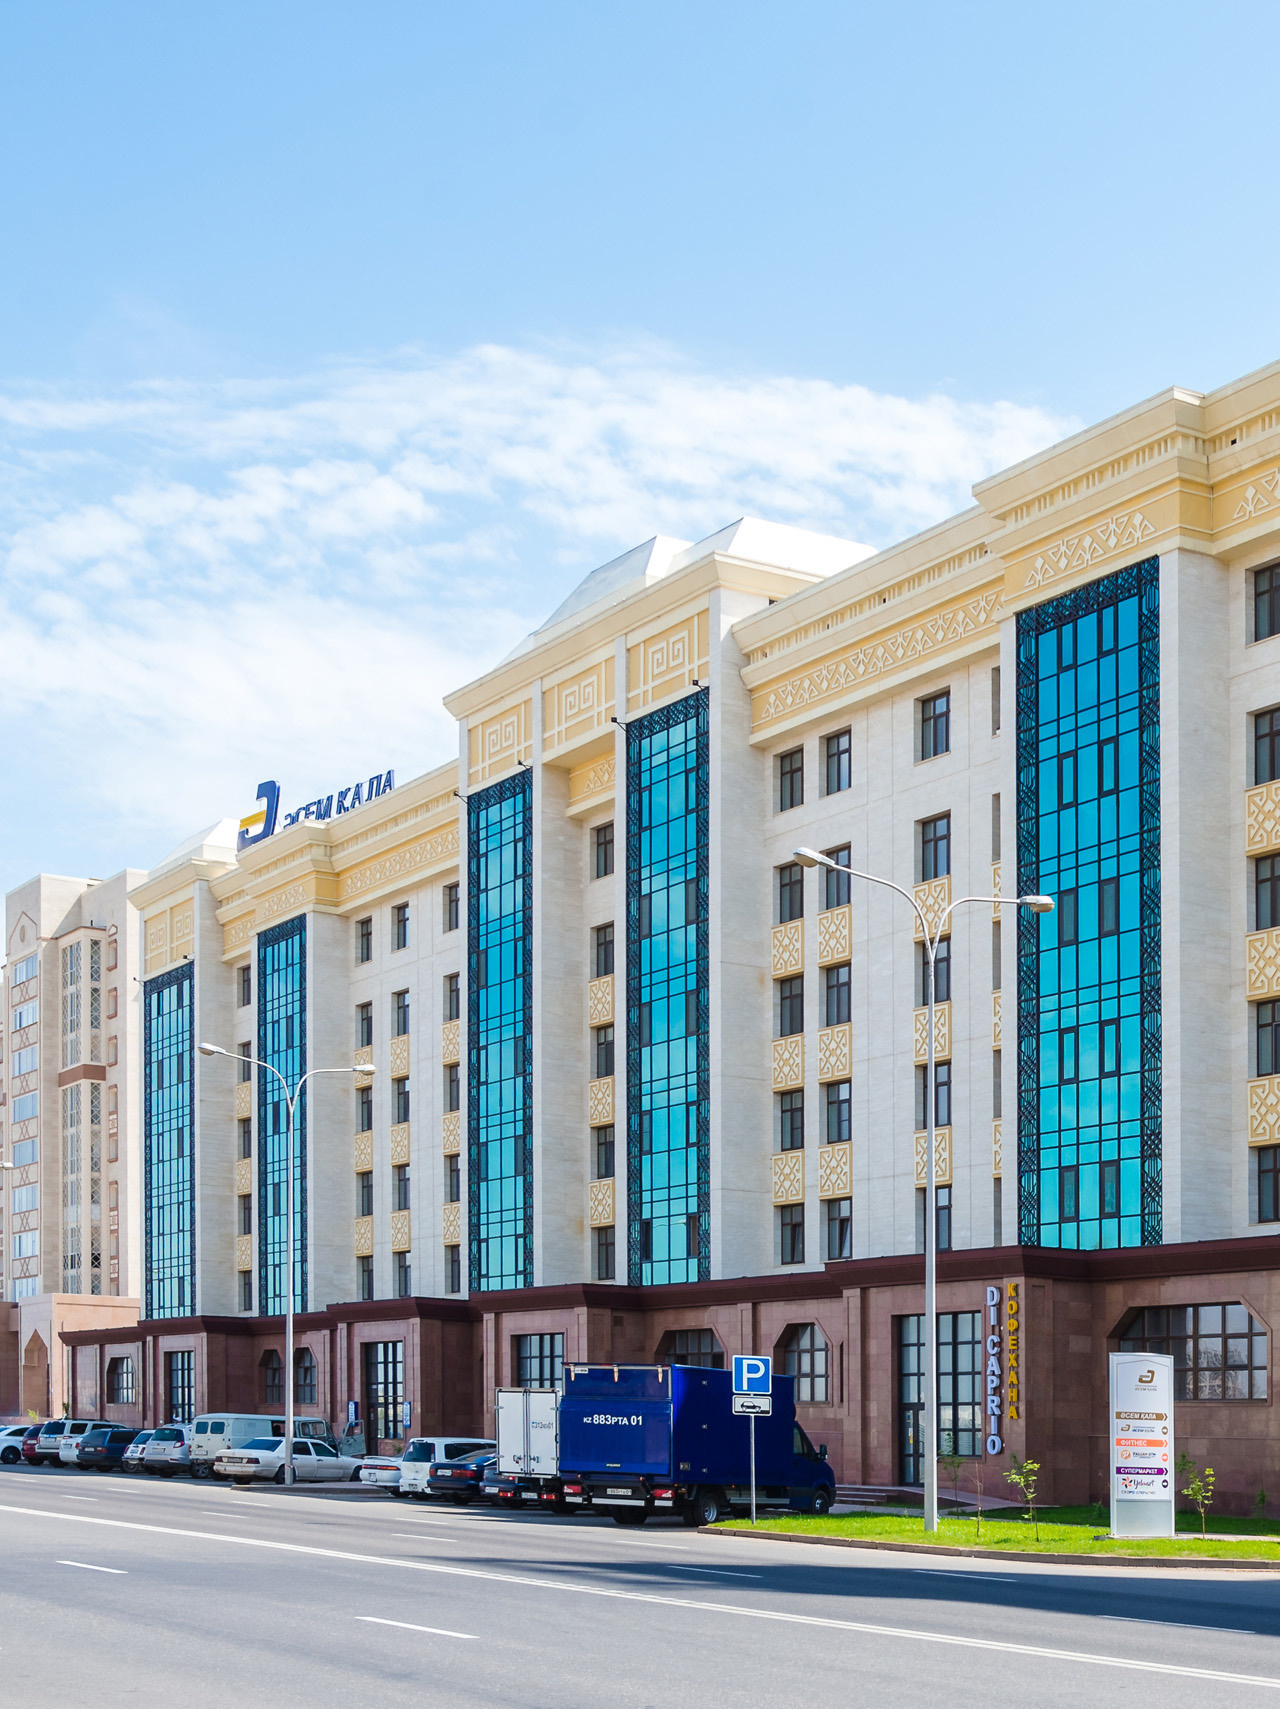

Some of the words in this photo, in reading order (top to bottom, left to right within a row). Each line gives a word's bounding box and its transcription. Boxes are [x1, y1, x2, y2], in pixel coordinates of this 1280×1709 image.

[986, 1286, 1000, 1326] DI
[1007, 1283, 1019, 1419] КОФЕХАНА
[742, 1359, 765, 1391] P
[986, 1335, 1001, 1455] CAPRIO
[583, 1416, 592, 1424] KZ
[630, 1415, 643, 1426] 01
